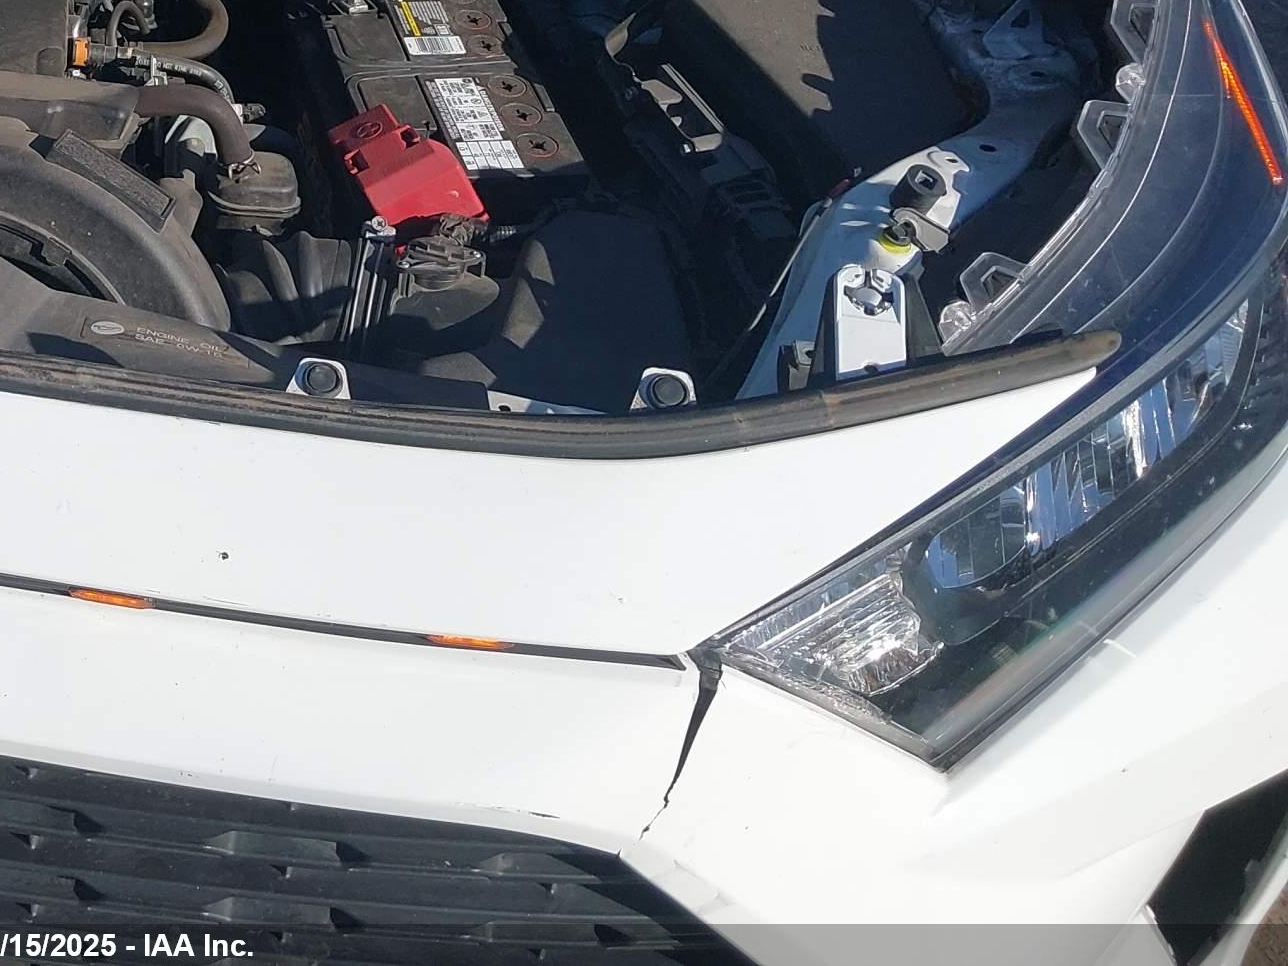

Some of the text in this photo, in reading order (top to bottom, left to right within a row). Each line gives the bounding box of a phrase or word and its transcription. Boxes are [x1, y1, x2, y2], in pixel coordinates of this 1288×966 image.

[135, 334, 168, 345] SAE
[136, 327, 224, 352] ENGINE OIL
